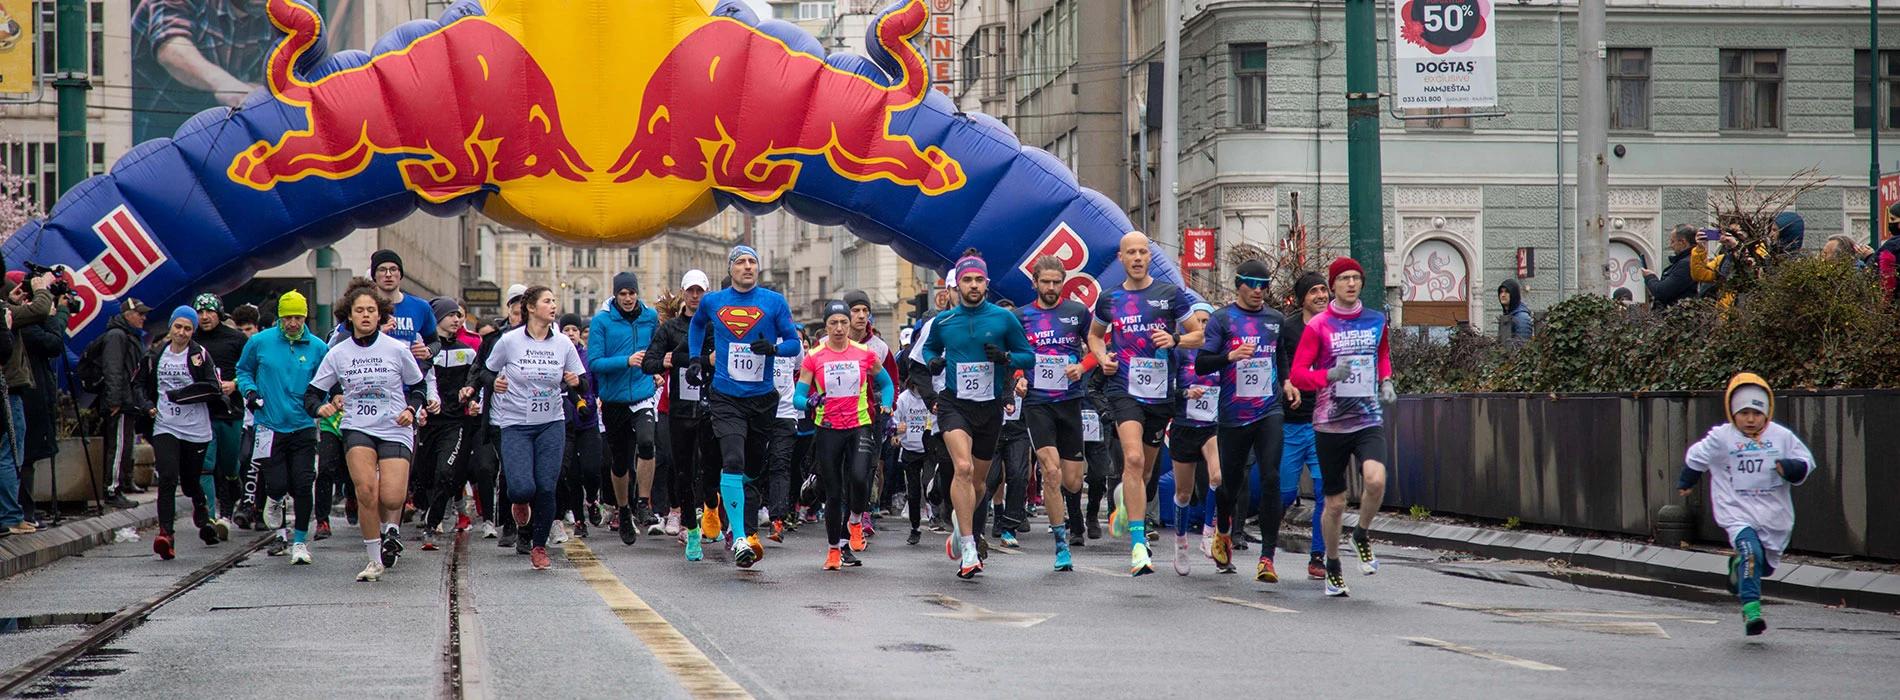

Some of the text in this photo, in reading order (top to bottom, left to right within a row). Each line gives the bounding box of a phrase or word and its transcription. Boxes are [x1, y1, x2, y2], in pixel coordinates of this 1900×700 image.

[1424, 5, 1474, 32] 50%
[1416, 59, 1474, 75] DOĞTAŞ
[1423, 84, 1471, 93] NAMJEŠTAJ
[1019, 222, 1106, 318] Re
[396, 317, 414, 330] KA
[1120, 315, 1142, 324] VISIT
[1034, 330, 1055, 338] VISIT
[1241, 336, 1261, 344] VISIT
[733, 358, 753, 370] 110
[1041, 369, 1054, 379] 28
[835, 376, 841, 386] 1
[966, 379, 979, 390] 25
[1137, 374, 1151, 385] 39
[1245, 374, 1258, 385] 29
[357, 404, 377, 416] 206
[531, 402, 550, 412] 213
[1195, 400, 1208, 410] 20
[170, 406, 181, 416] 19
[910, 425, 925, 433] 224
[1738, 459, 1764, 473] 407
